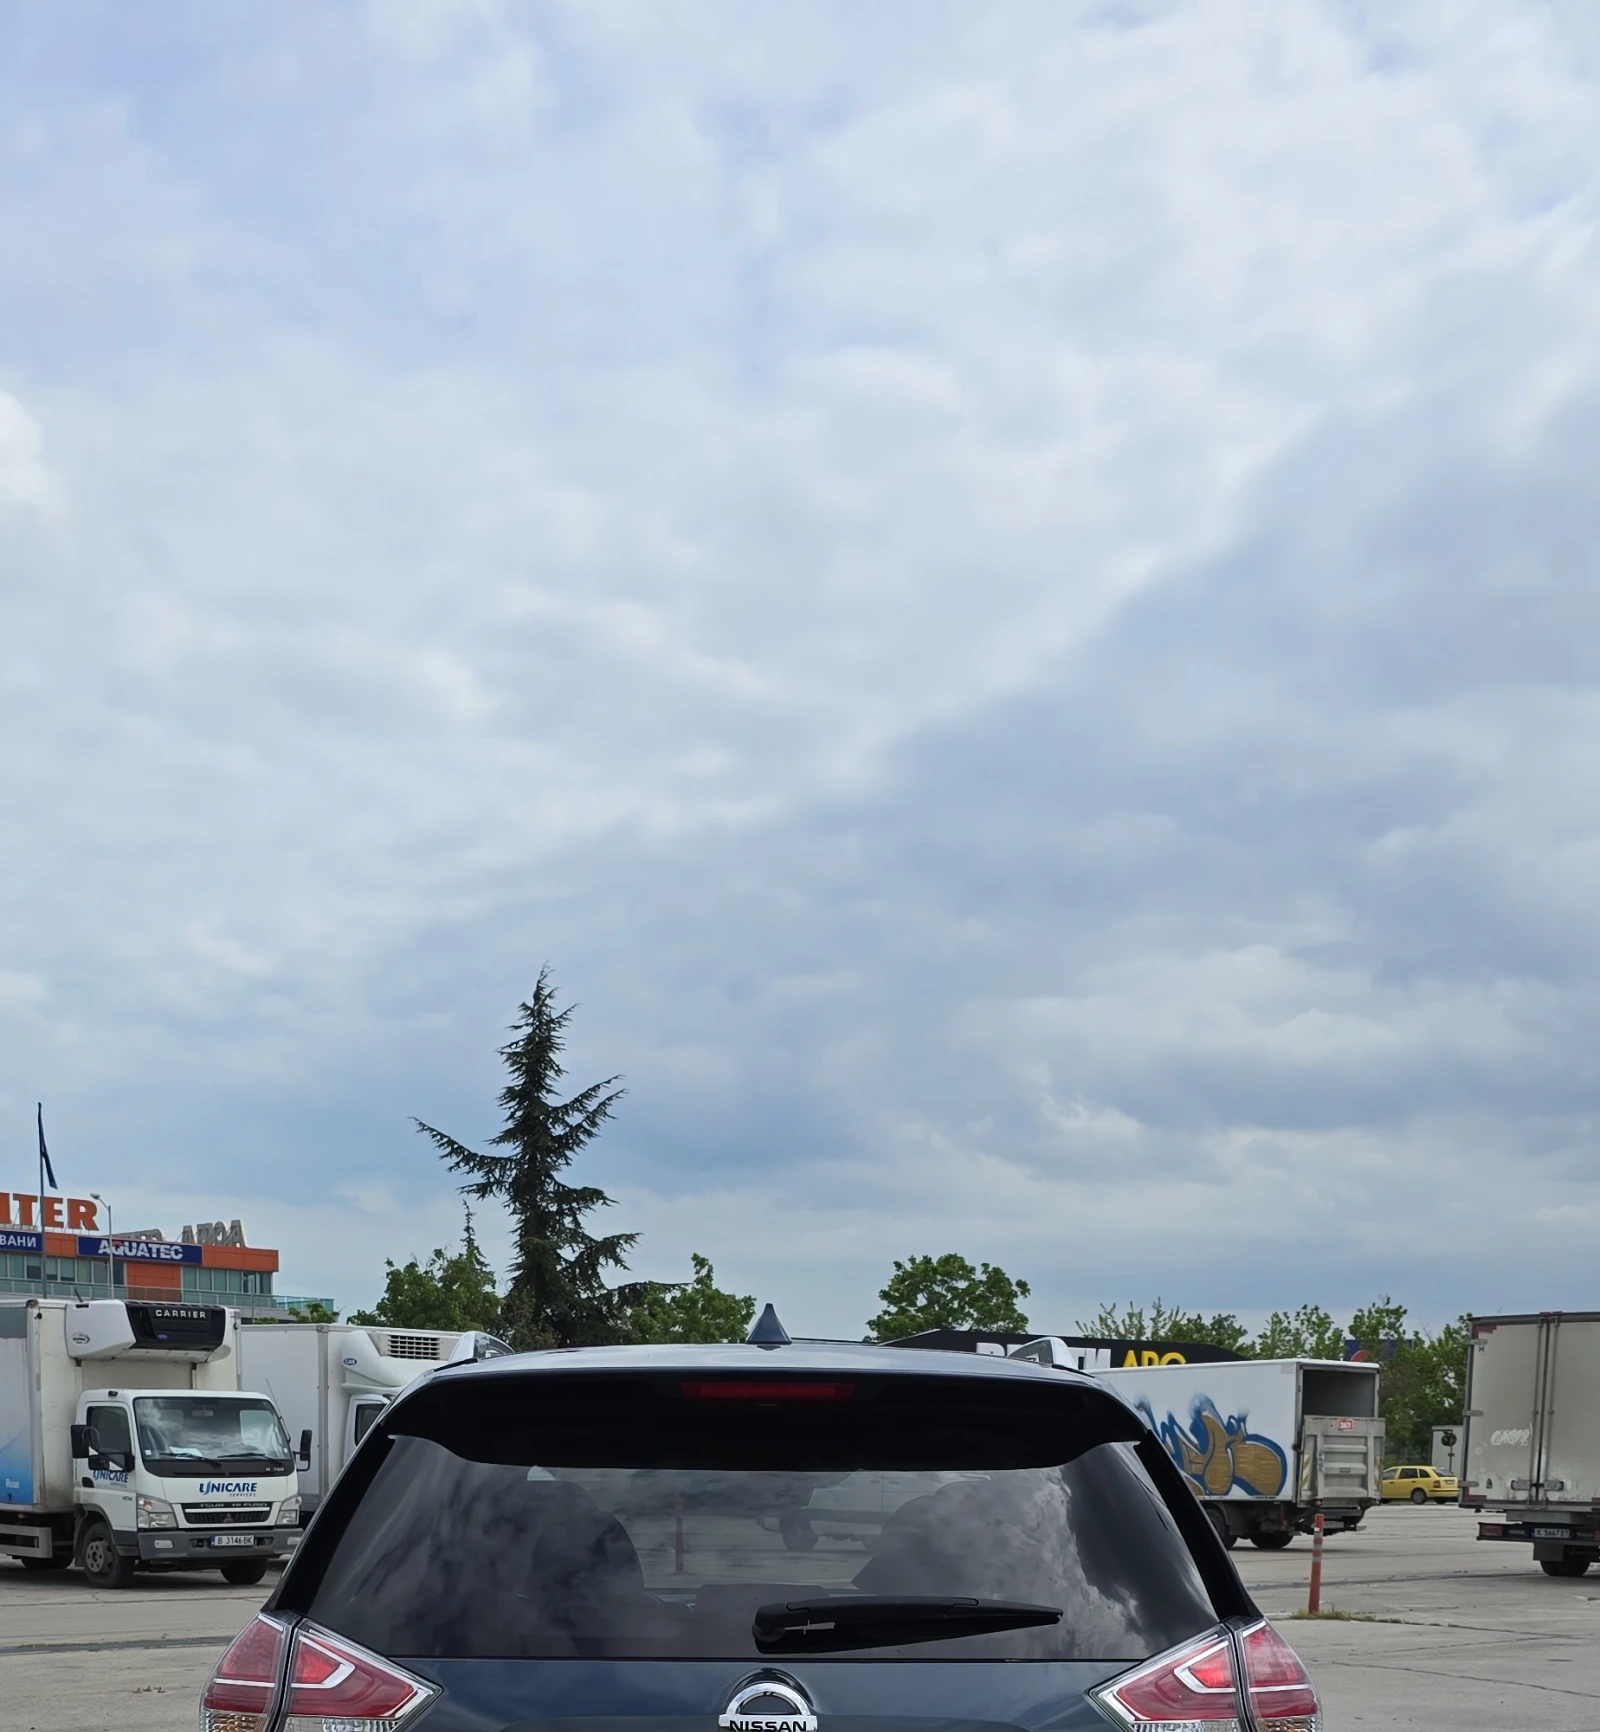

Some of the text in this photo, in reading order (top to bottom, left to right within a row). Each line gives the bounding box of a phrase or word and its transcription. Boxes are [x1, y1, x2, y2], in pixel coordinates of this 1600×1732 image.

[98, 1239, 183, 1260] AQUATEC
[155, 1309, 206, 1318] CARRIER
[199, 1481, 257, 1495] UNICARE
[729, 1720, 807, 1732] NISSAN
